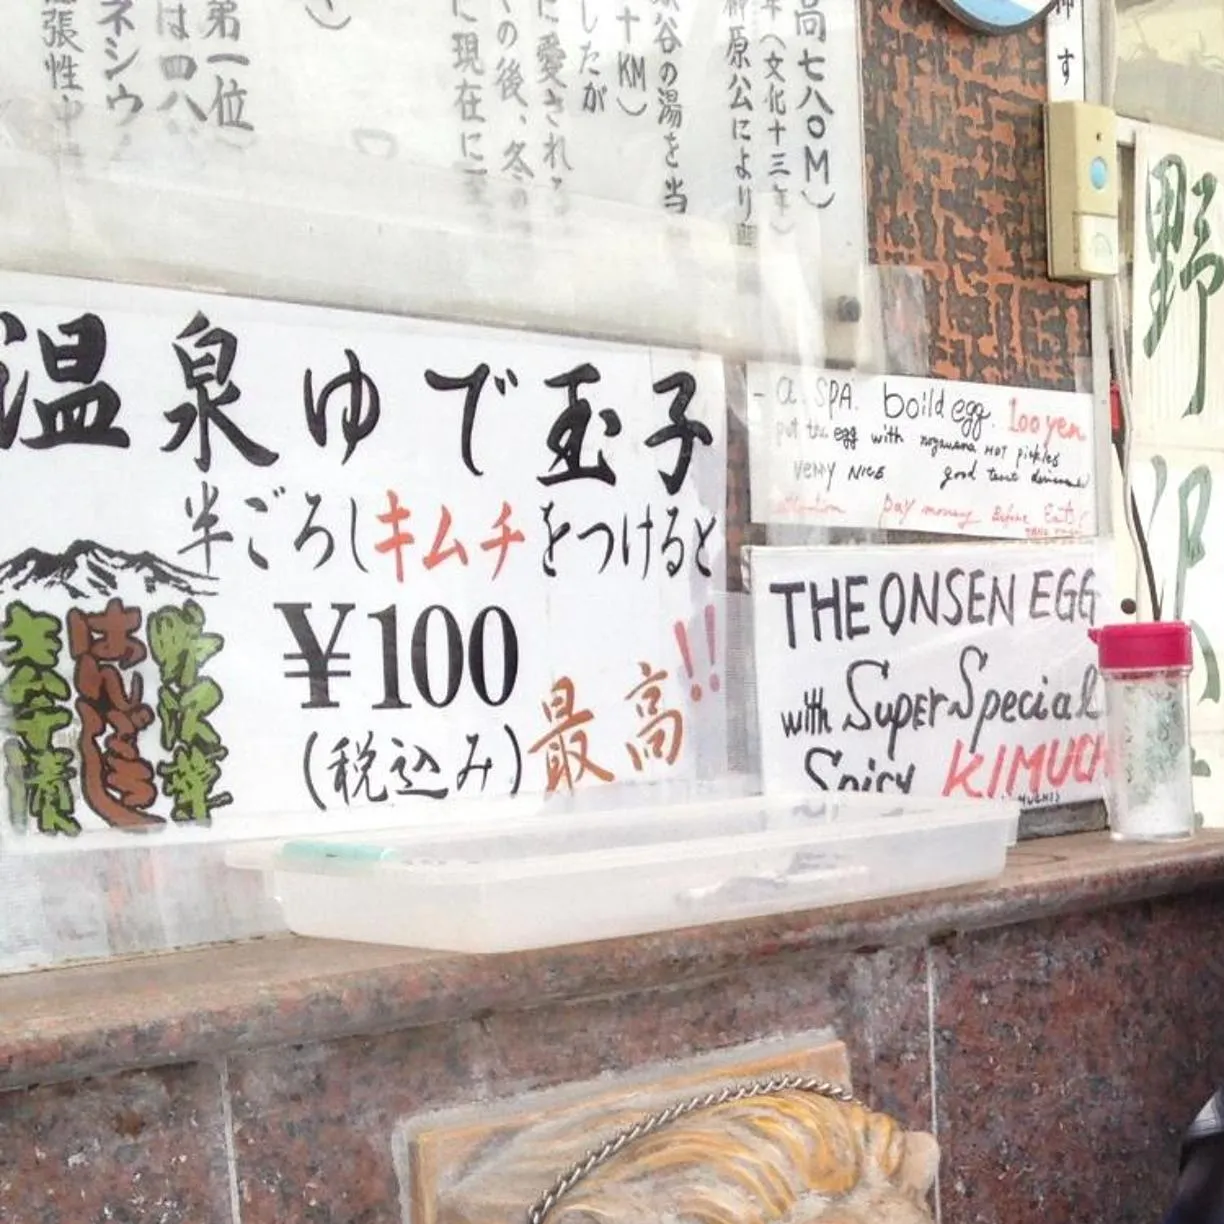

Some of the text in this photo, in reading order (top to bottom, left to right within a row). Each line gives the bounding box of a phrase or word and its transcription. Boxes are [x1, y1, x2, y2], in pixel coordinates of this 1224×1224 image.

[652, 0, 689, 215] 谷の湯を当
[0, 311, 714, 495] 温泉ゆで玉子
[833, 425, 859, 451] egg
[870, 423, 905, 445] with
[769, 575, 871, 650] THE
[878, 568, 1017, 637] ONSEN
[780, 686, 833, 739] with
[947, 645, 1102, 754] Special
